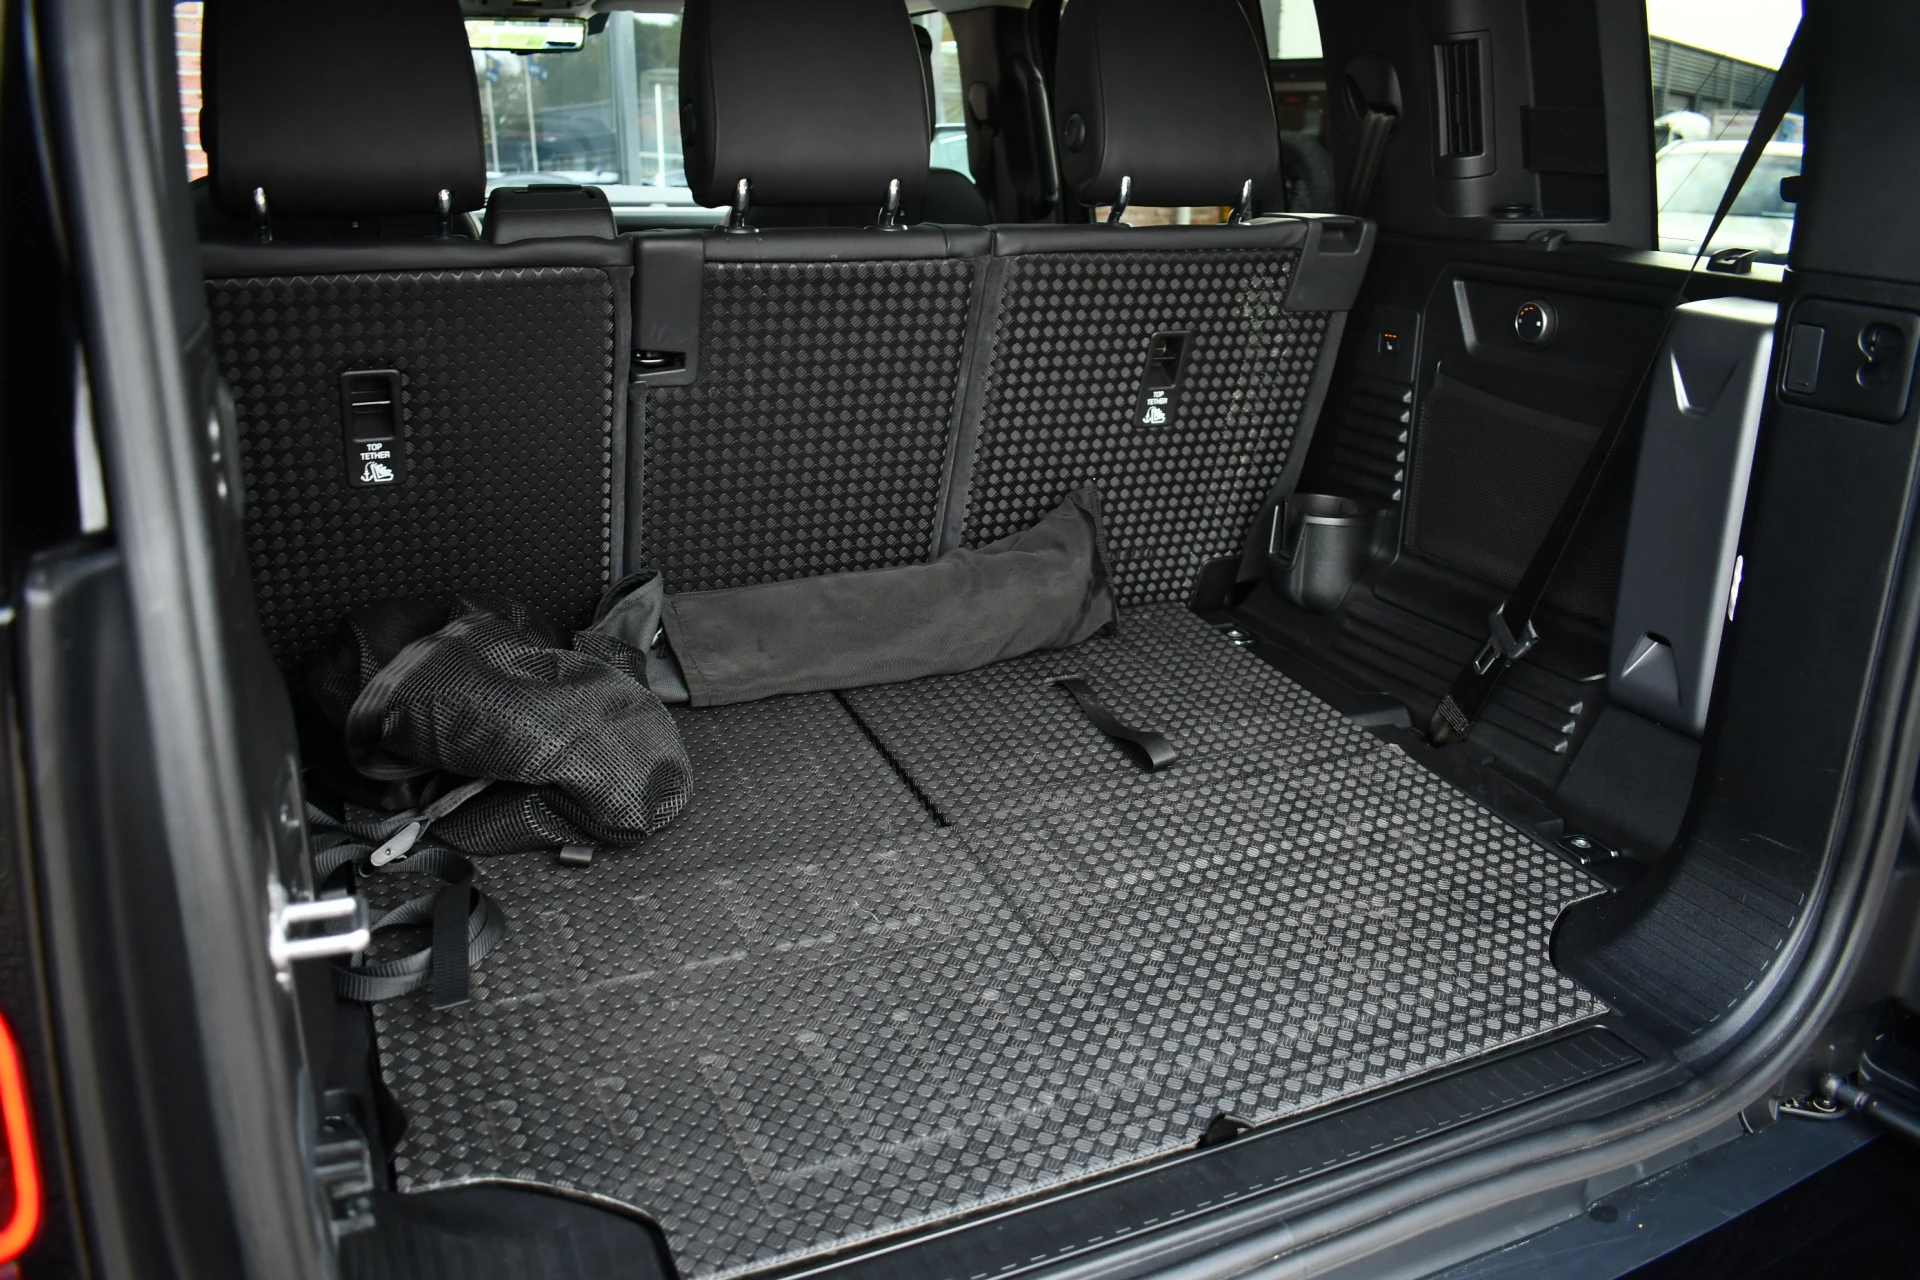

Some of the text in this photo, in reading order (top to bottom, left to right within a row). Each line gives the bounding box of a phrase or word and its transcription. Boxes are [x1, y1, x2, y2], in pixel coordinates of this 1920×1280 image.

[1153, 390, 1165, 398] TOP
[1146, 397, 1168, 405] TETHER
[366, 443, 383, 451] TOP
[360, 451, 391, 460] TETHER
